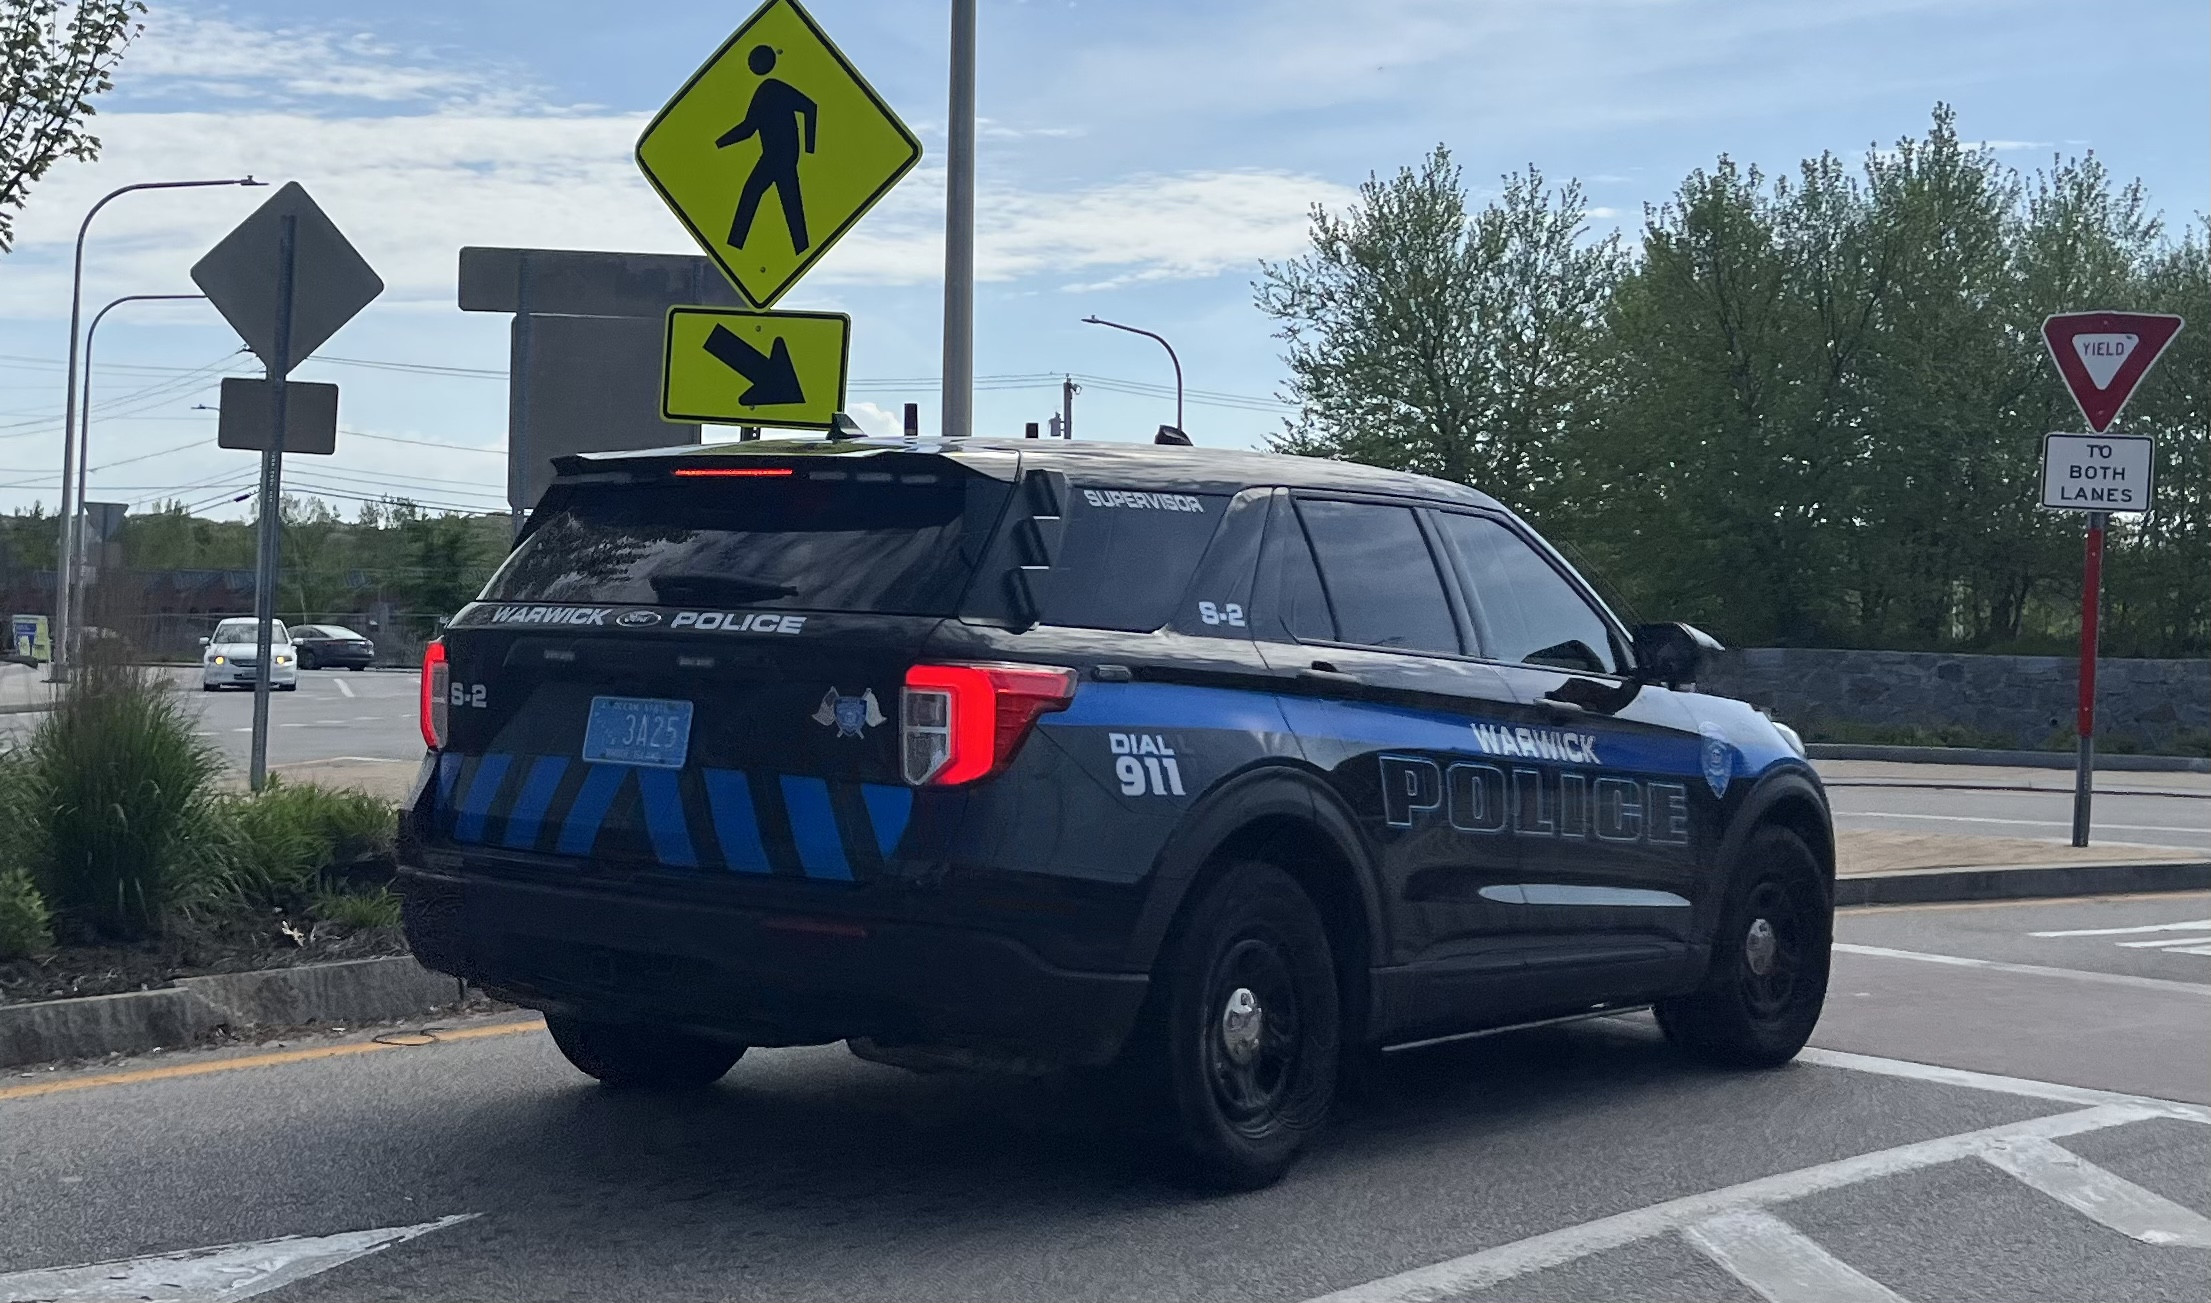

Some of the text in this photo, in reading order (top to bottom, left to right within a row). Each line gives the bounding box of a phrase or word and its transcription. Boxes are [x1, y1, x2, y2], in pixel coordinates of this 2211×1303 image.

[2083, 342, 2125, 356] YIELD
[2086, 444, 2112, 459] TO
[2069, 465, 2126, 481] BOTH
[1083, 489, 1204, 513] SUPERVISOR
[2060, 486, 2133, 503] LANES
[490, 606, 612, 626] WARWICK
[670, 611, 807, 634] POLICE
[1198, 601, 1246, 627] S-2
[450, 682, 487, 708] S-2
[622, 713, 680, 748] 3A25
[1108, 732, 1175, 755] DIAL
[1470, 721, 1602, 765] WARWICK
[1115, 756, 1187, 796] 911
[1378, 754, 1689, 846] POLICE
